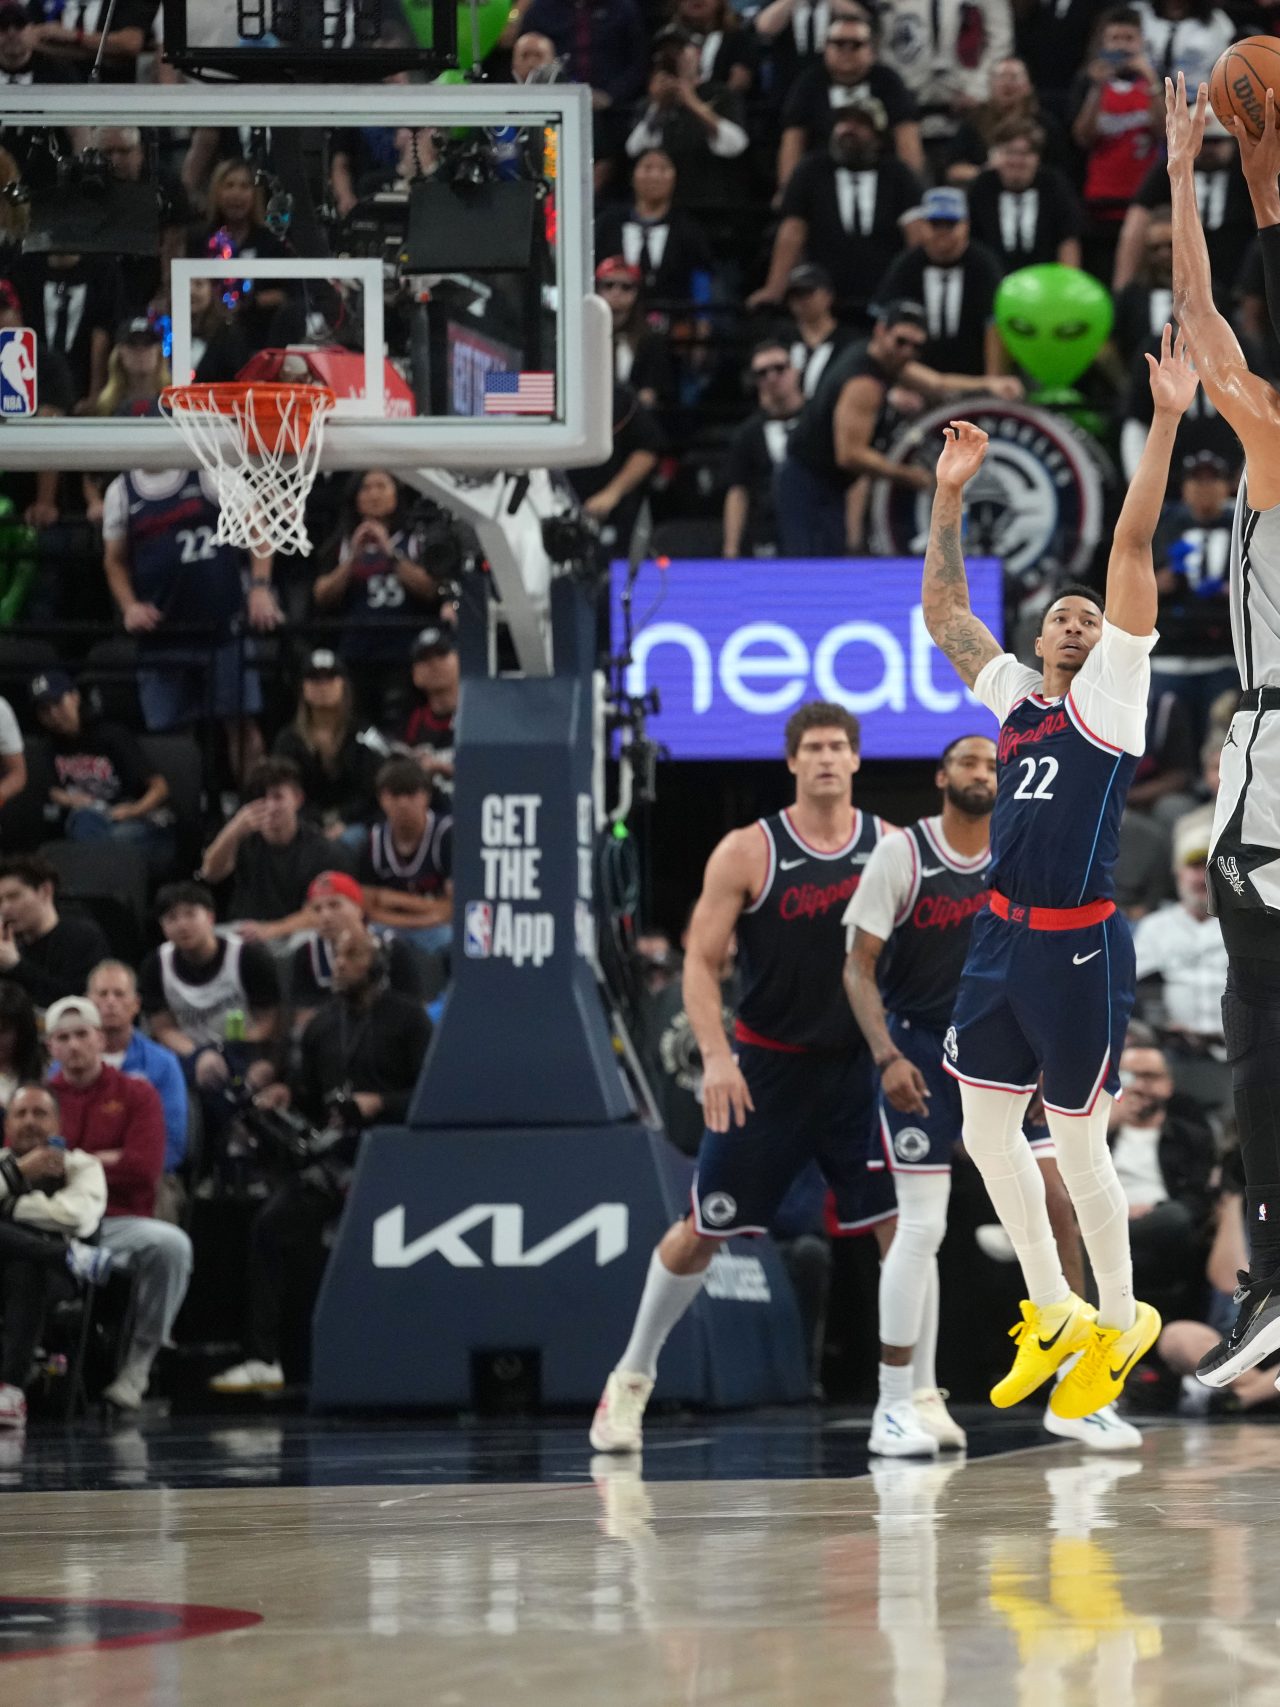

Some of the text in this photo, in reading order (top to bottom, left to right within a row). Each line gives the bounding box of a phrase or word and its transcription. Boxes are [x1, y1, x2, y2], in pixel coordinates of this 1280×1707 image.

[176, 525, 217, 565] 22
[997, 710, 1068, 765] lippers
[1013, 755, 1060, 801] 22
[481, 793, 543, 847] GET
[480, 847, 543, 900] THE
[779, 874, 861, 921] Clippe
[913, 889, 992, 930] Clippe
[493, 902, 556, 968] App
